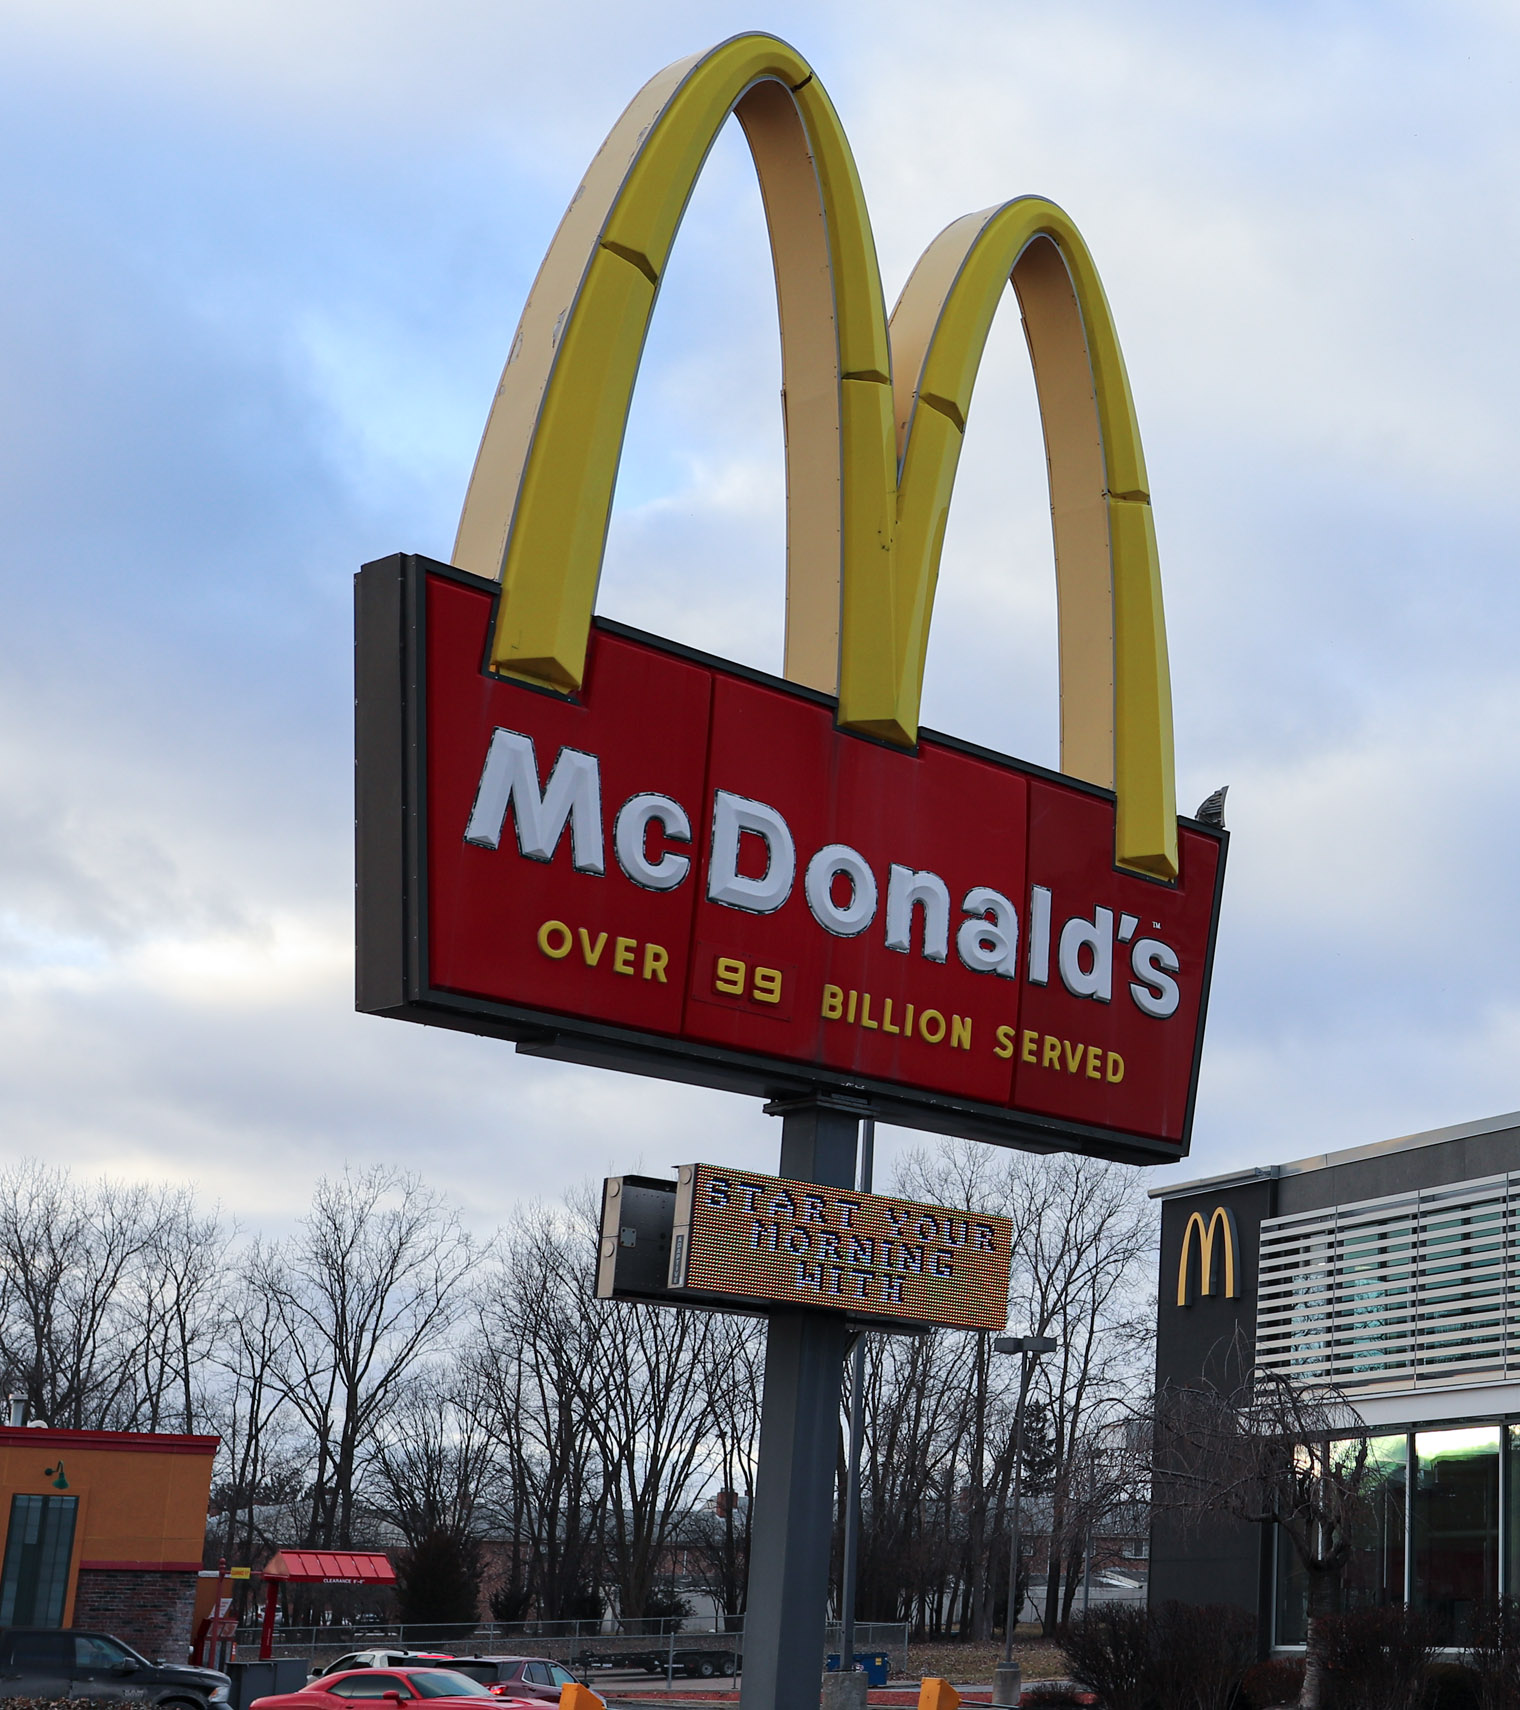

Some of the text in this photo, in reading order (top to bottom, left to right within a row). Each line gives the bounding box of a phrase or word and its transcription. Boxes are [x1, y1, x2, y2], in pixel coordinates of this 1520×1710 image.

[463, 725, 1181, 1018] McDonald's
[537, 919, 1126, 1084] OVER 99 BILLION SERVED
[703, 1177, 997, 1254] START YOUR
[749, 1218, 954, 1278] MORNING
[796, 1261, 908, 1303] WITH
